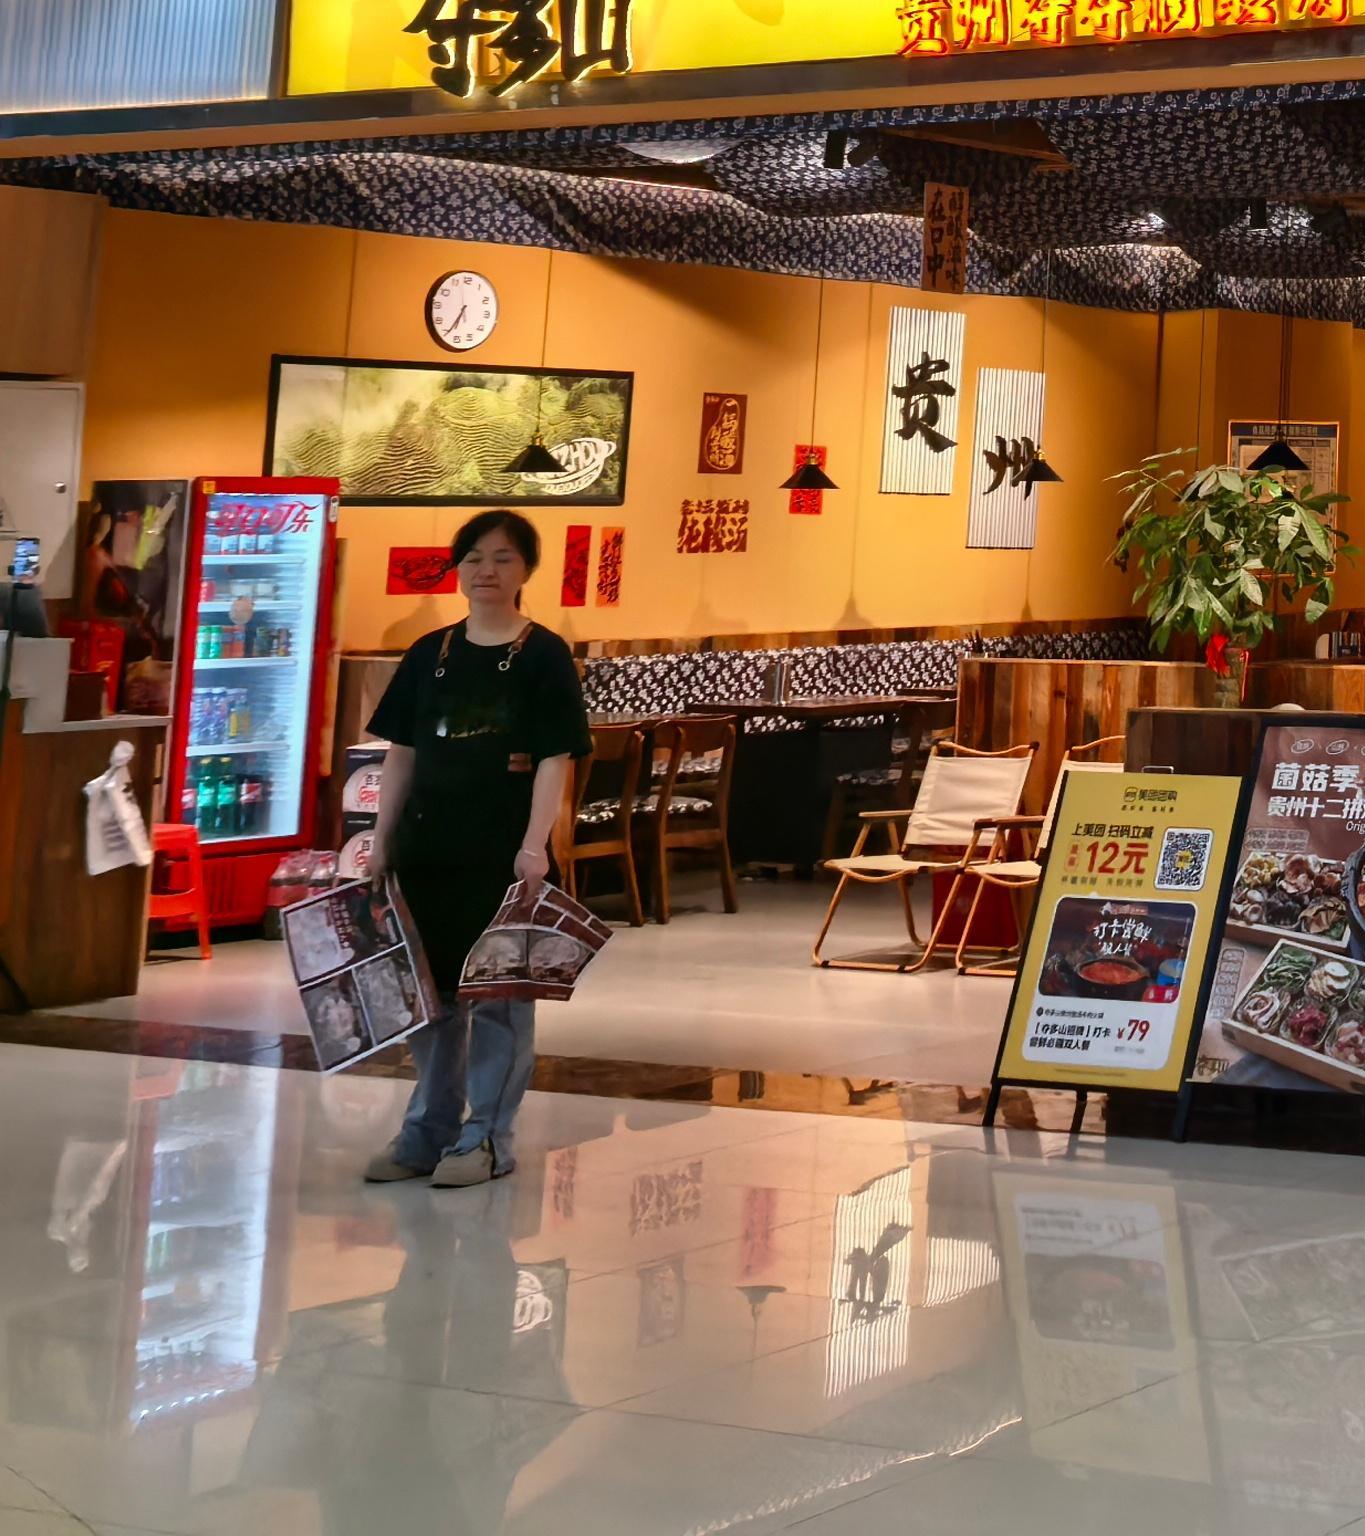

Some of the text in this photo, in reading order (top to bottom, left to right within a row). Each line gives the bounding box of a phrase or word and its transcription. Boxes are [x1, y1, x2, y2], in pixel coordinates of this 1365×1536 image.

[892, 352, 958, 453] 贵
[983, 435, 1037, 501] 州
[1272, 762, 1359, 793] 菌菇季
[1072, 823, 1154, 839] 上美团 扫码立减
[1086, 841, 1149, 874] 12元
